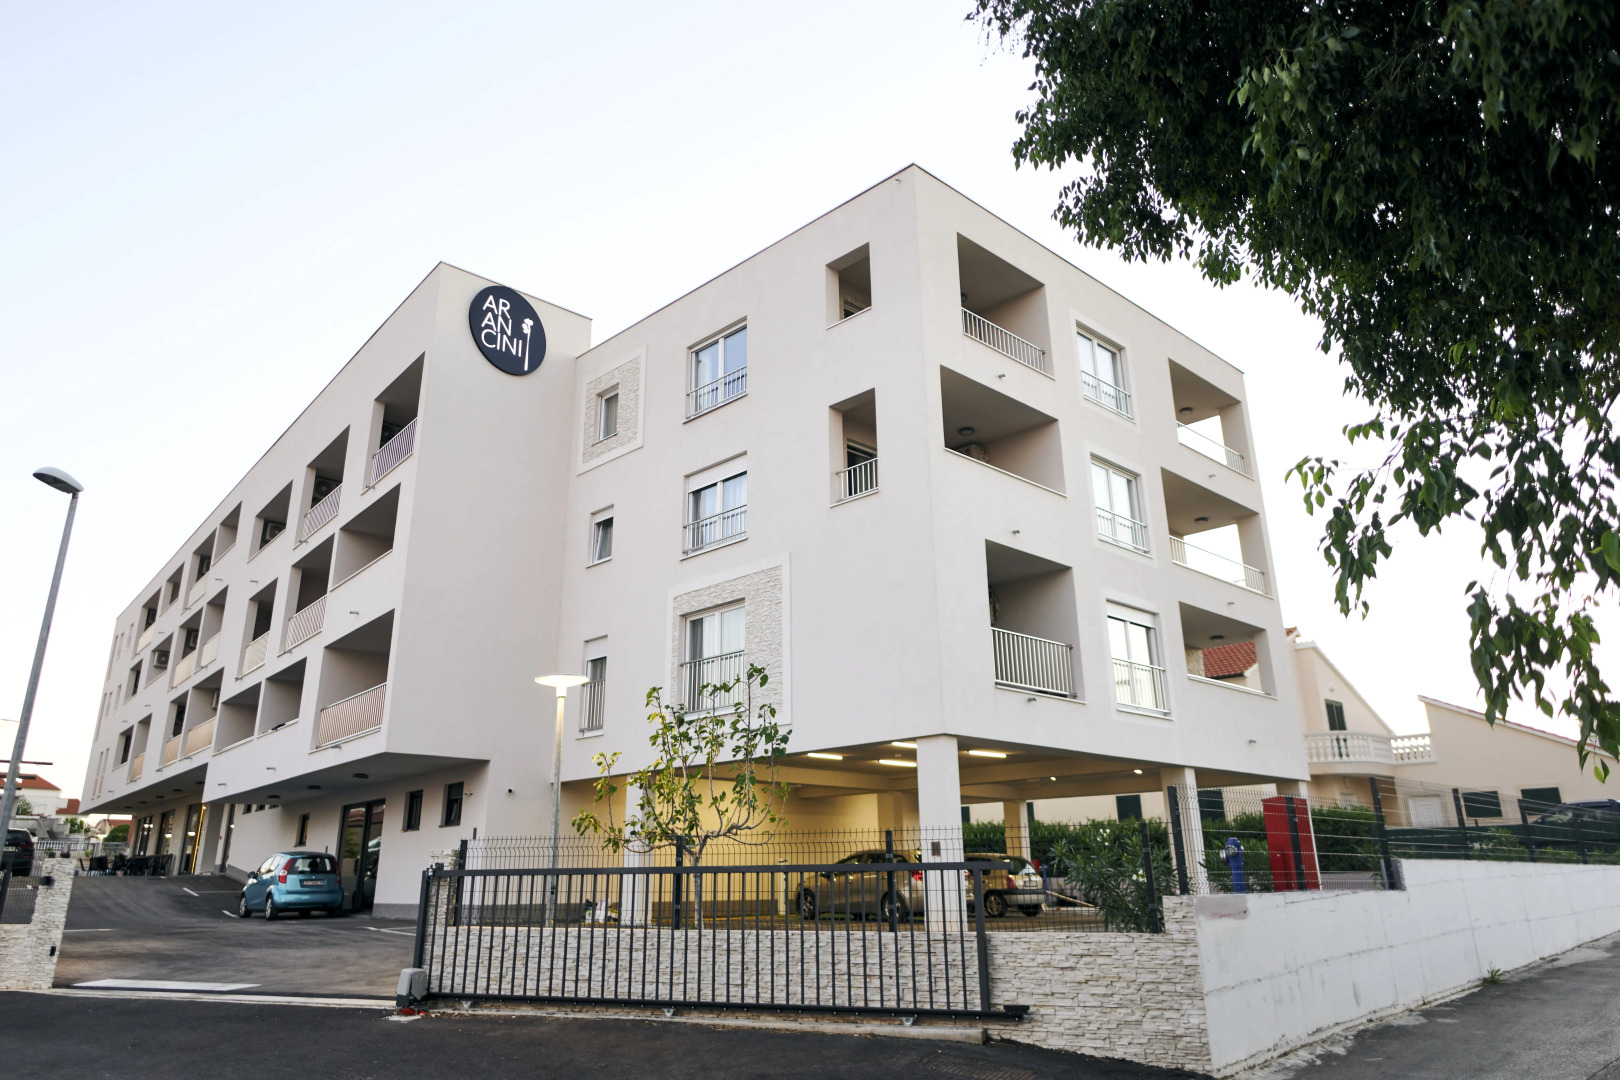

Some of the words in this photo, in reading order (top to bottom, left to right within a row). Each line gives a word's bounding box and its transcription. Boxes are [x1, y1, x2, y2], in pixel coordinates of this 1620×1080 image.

[482, 294, 511, 319] AR
[481, 311, 512, 337] AN
[481, 329, 522, 358] CINI
